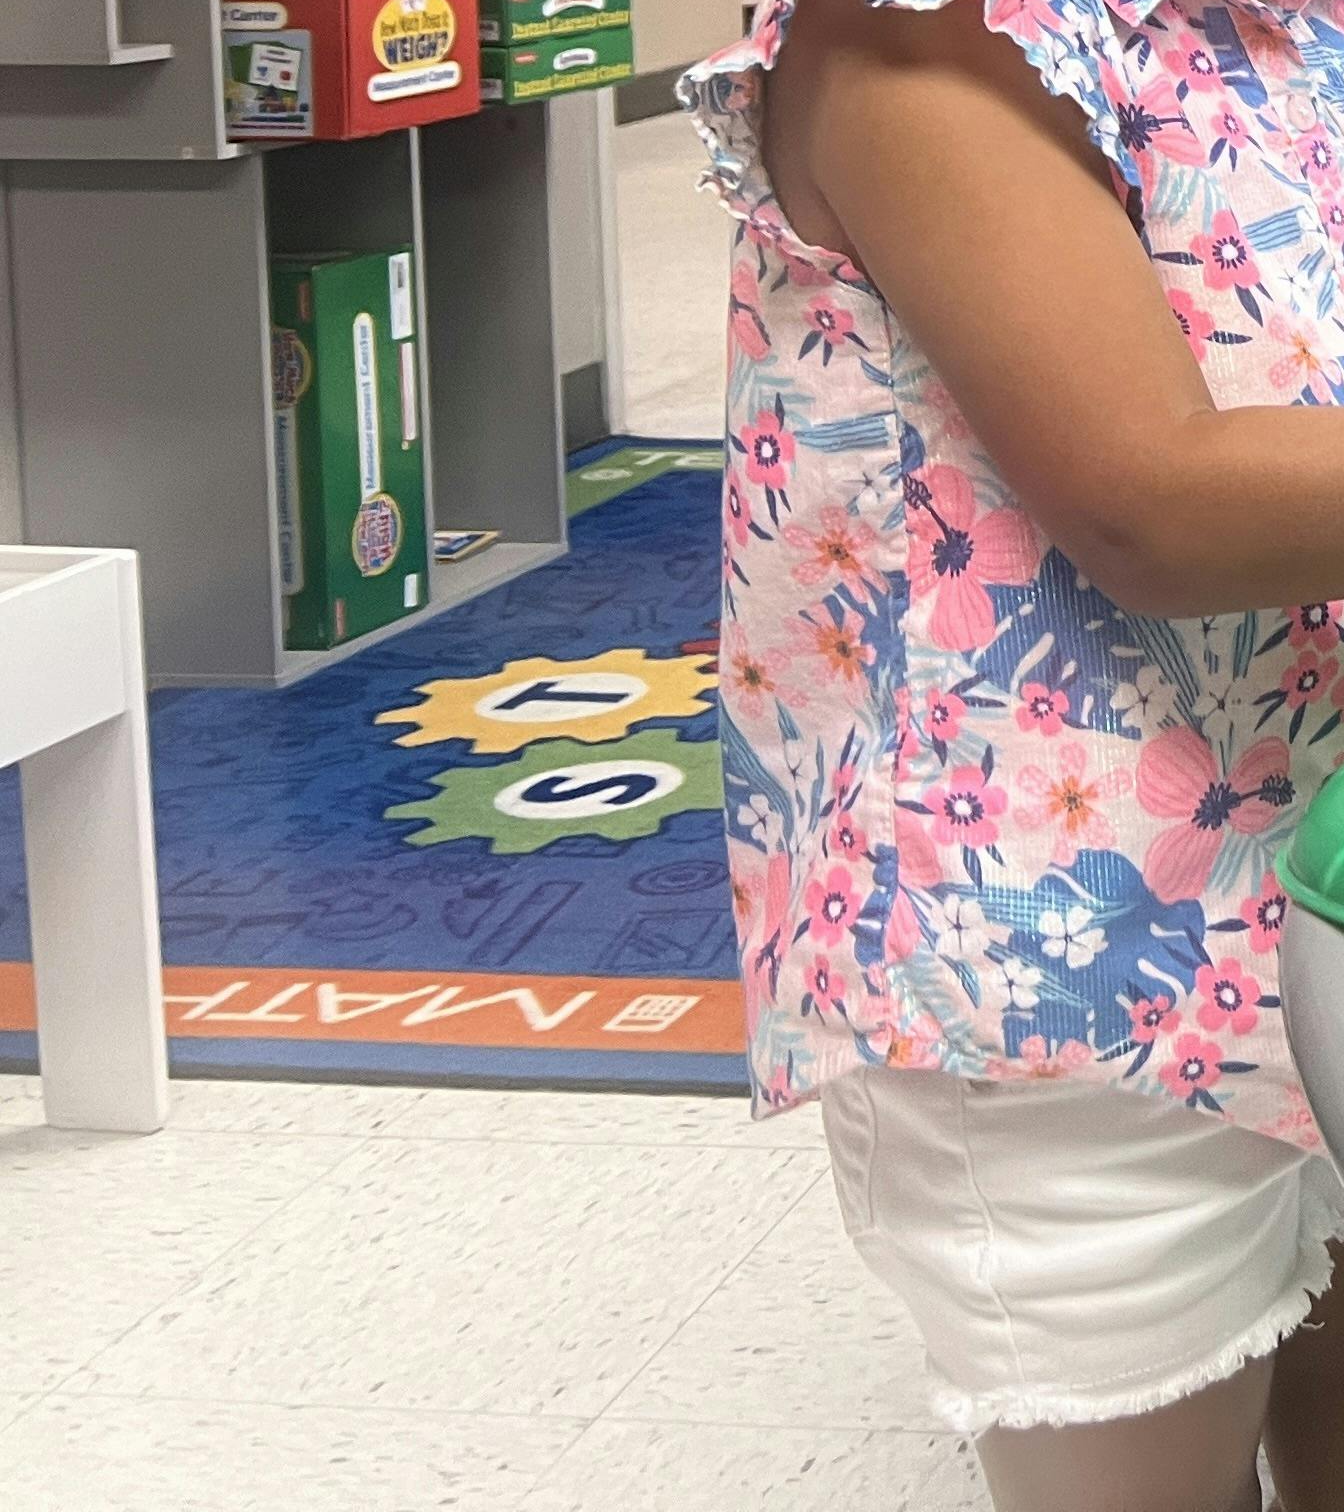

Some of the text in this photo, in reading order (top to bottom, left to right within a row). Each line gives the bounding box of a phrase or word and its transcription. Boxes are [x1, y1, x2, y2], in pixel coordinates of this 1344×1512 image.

[383, 31, 449, 65] WEIGH?
[491, 681, 630, 712] T
[521, 773, 657, 806] S
